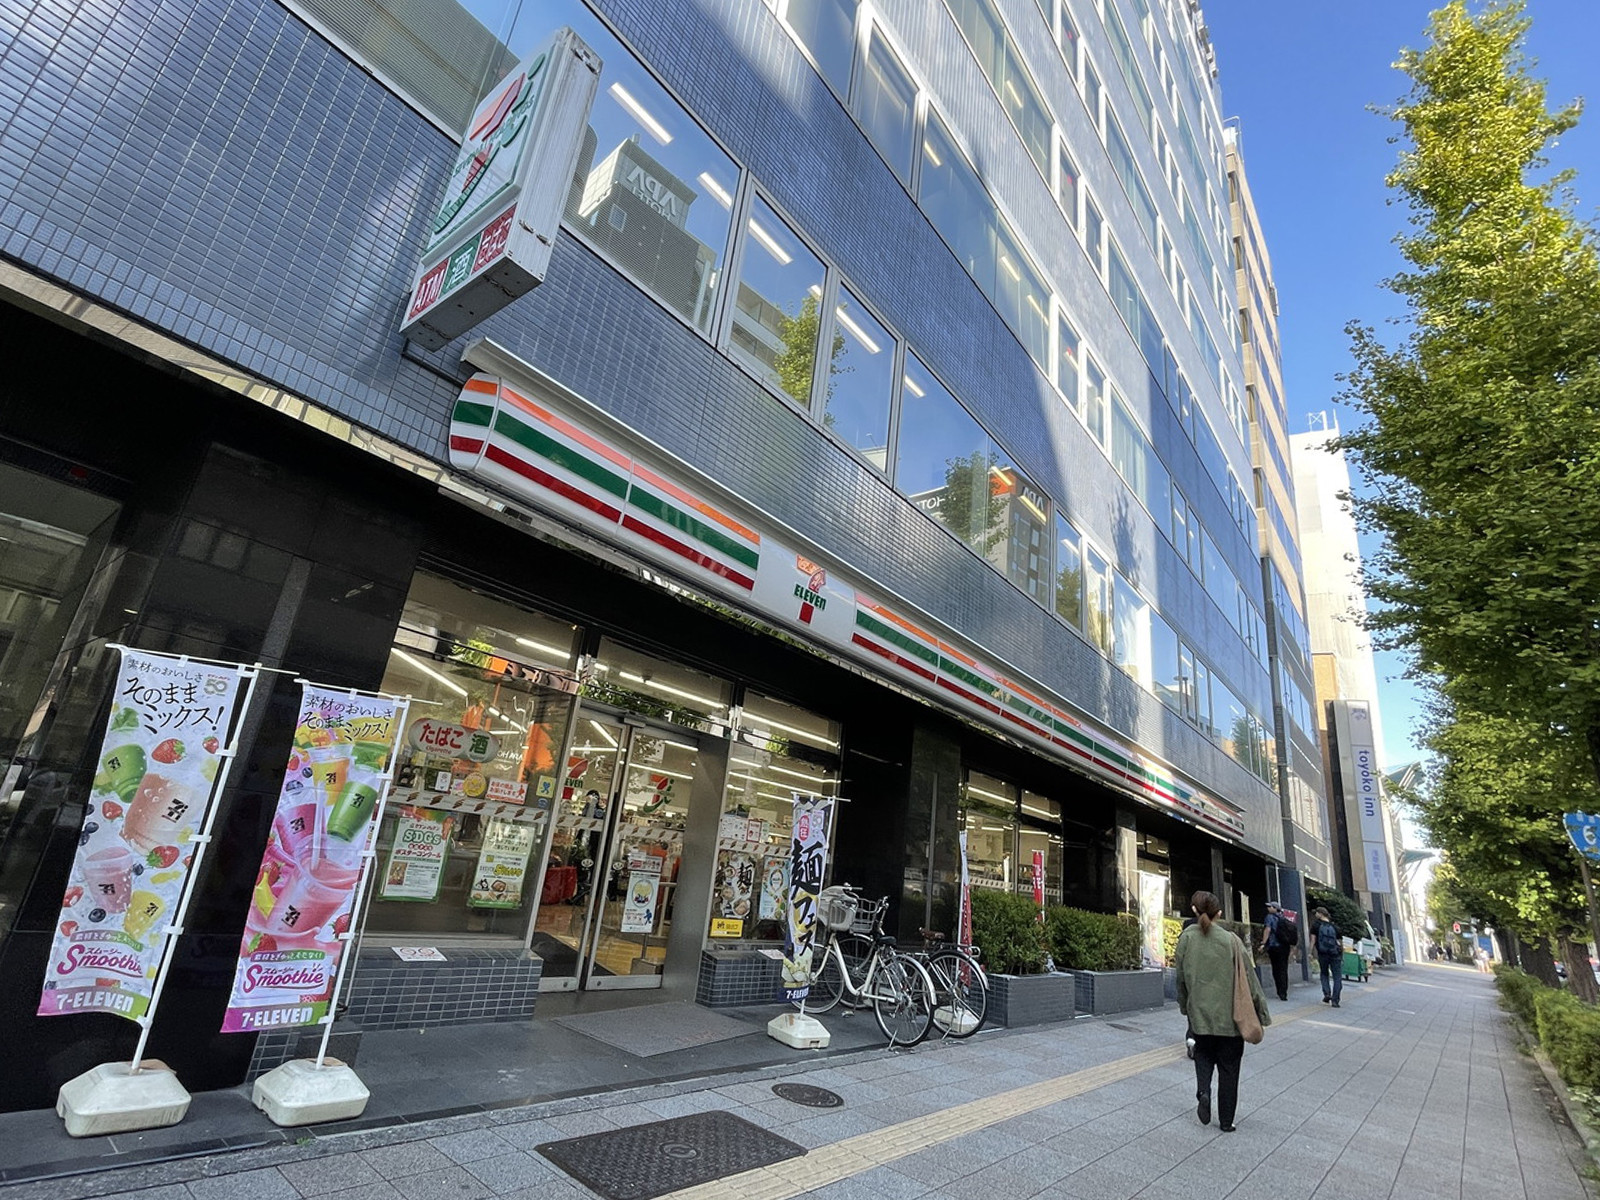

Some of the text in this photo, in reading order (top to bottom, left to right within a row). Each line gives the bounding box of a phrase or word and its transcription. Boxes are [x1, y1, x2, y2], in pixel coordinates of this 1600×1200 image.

[413, 270, 445, 311] ATM
[127, 658, 204, 682] 素材のおいしさ
[123, 677, 197, 705] そのまま
[305, 694, 393, 722] 素材のおいしさ
[420, 723, 490, 755] たばこ 酒
[1358, 750, 1376, 818] toyoko inn
[402, 829, 442, 845] SDGs
[243, 964, 324, 993] Smoothie
